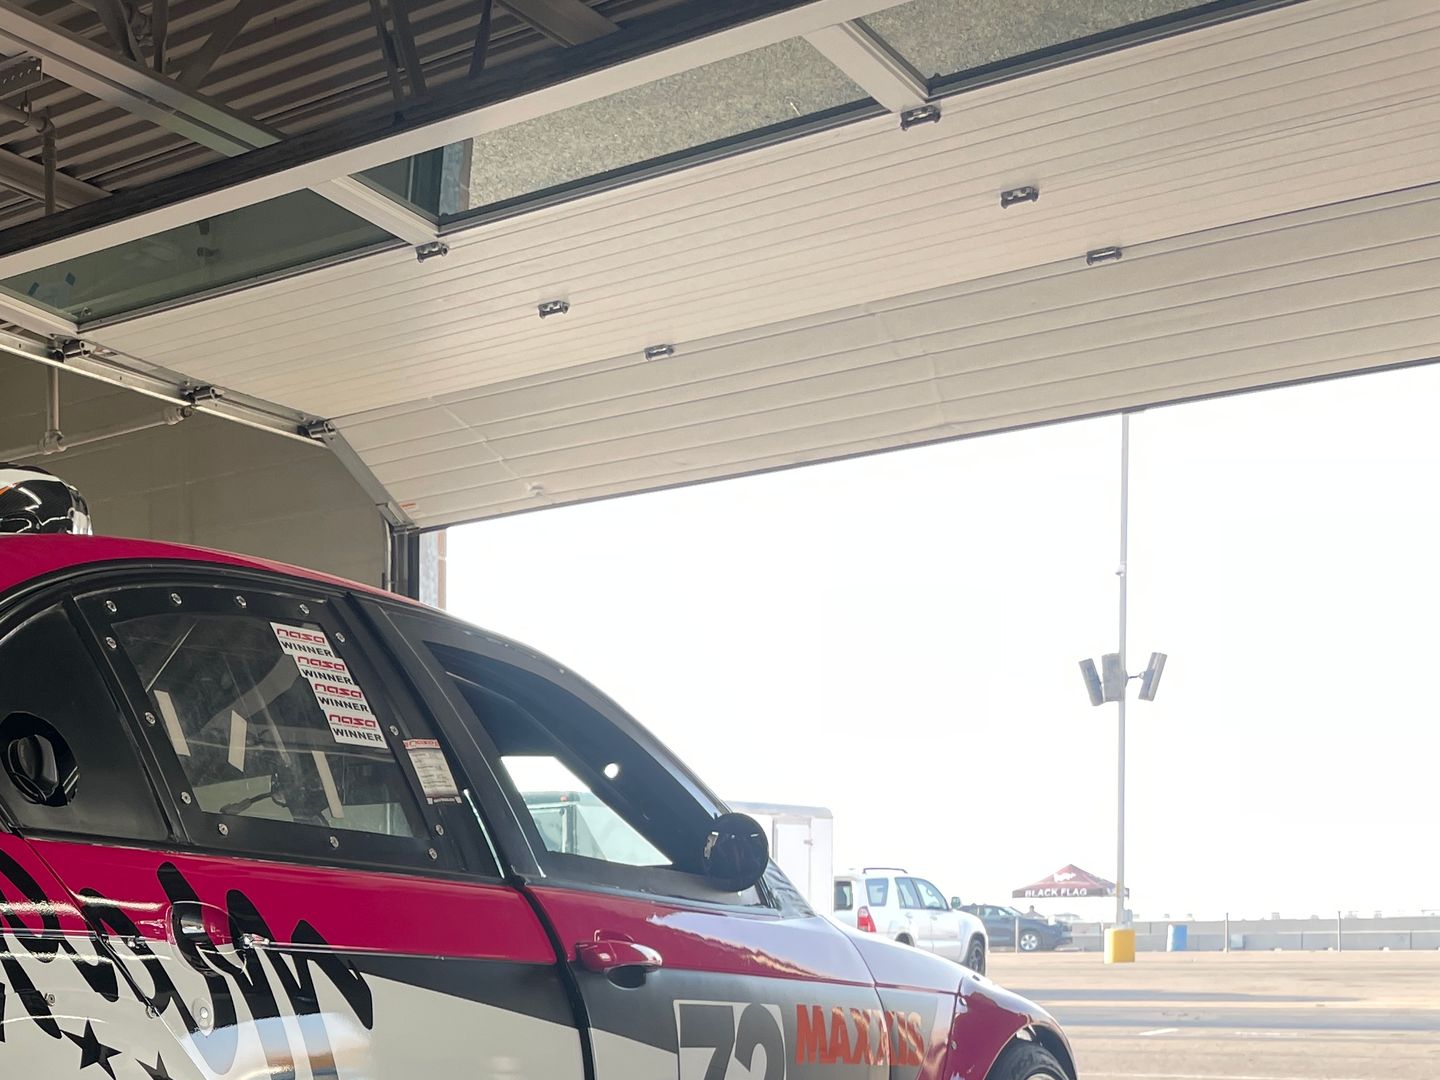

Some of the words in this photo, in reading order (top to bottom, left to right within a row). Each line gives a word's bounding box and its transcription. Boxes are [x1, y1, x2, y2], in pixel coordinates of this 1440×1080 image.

[277, 628, 326, 644] nasa
[280, 641, 333, 657] WINNER
[297, 656, 346, 672] nasa
[302, 668, 353, 685] WINNER
[314, 683, 363, 699] nasa
[318, 696, 370, 712] WINNER
[329, 713, 377, 728] nasa
[333, 728, 384, 742] WINNER
[1025, 887, 1058, 898] BLACK
[1060, 887, 1087, 897] FLAG
[795, 1004, 925, 1066] MAXXIS
